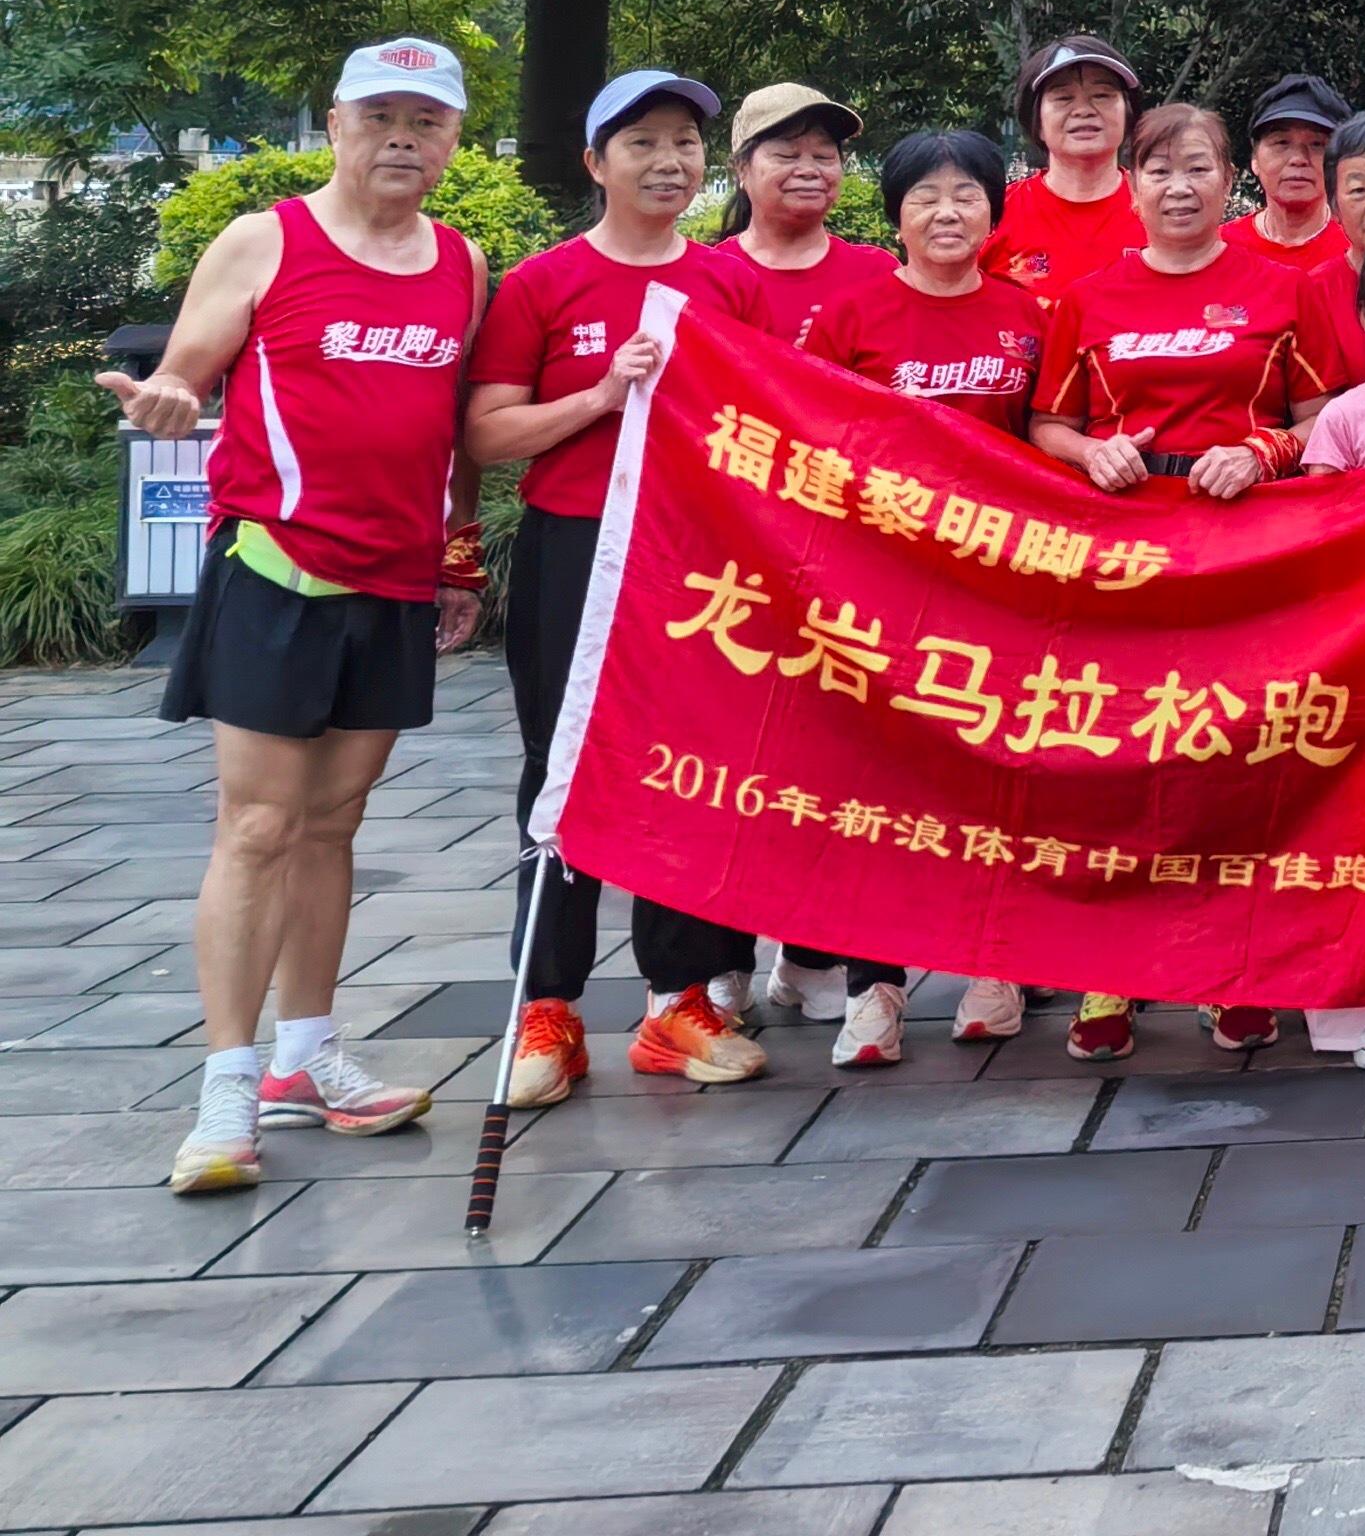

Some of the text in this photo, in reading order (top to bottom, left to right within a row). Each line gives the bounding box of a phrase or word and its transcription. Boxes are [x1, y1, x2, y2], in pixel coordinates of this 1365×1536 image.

[319, 321, 460, 364] 黎明脚步
[573, 321, 606, 338] 中国
[1106, 328, 1235, 358] 黎明脚步
[890, 355, 1029, 392] 黎明脚步
[704, 404, 1172, 591] 福建黎明脚步
